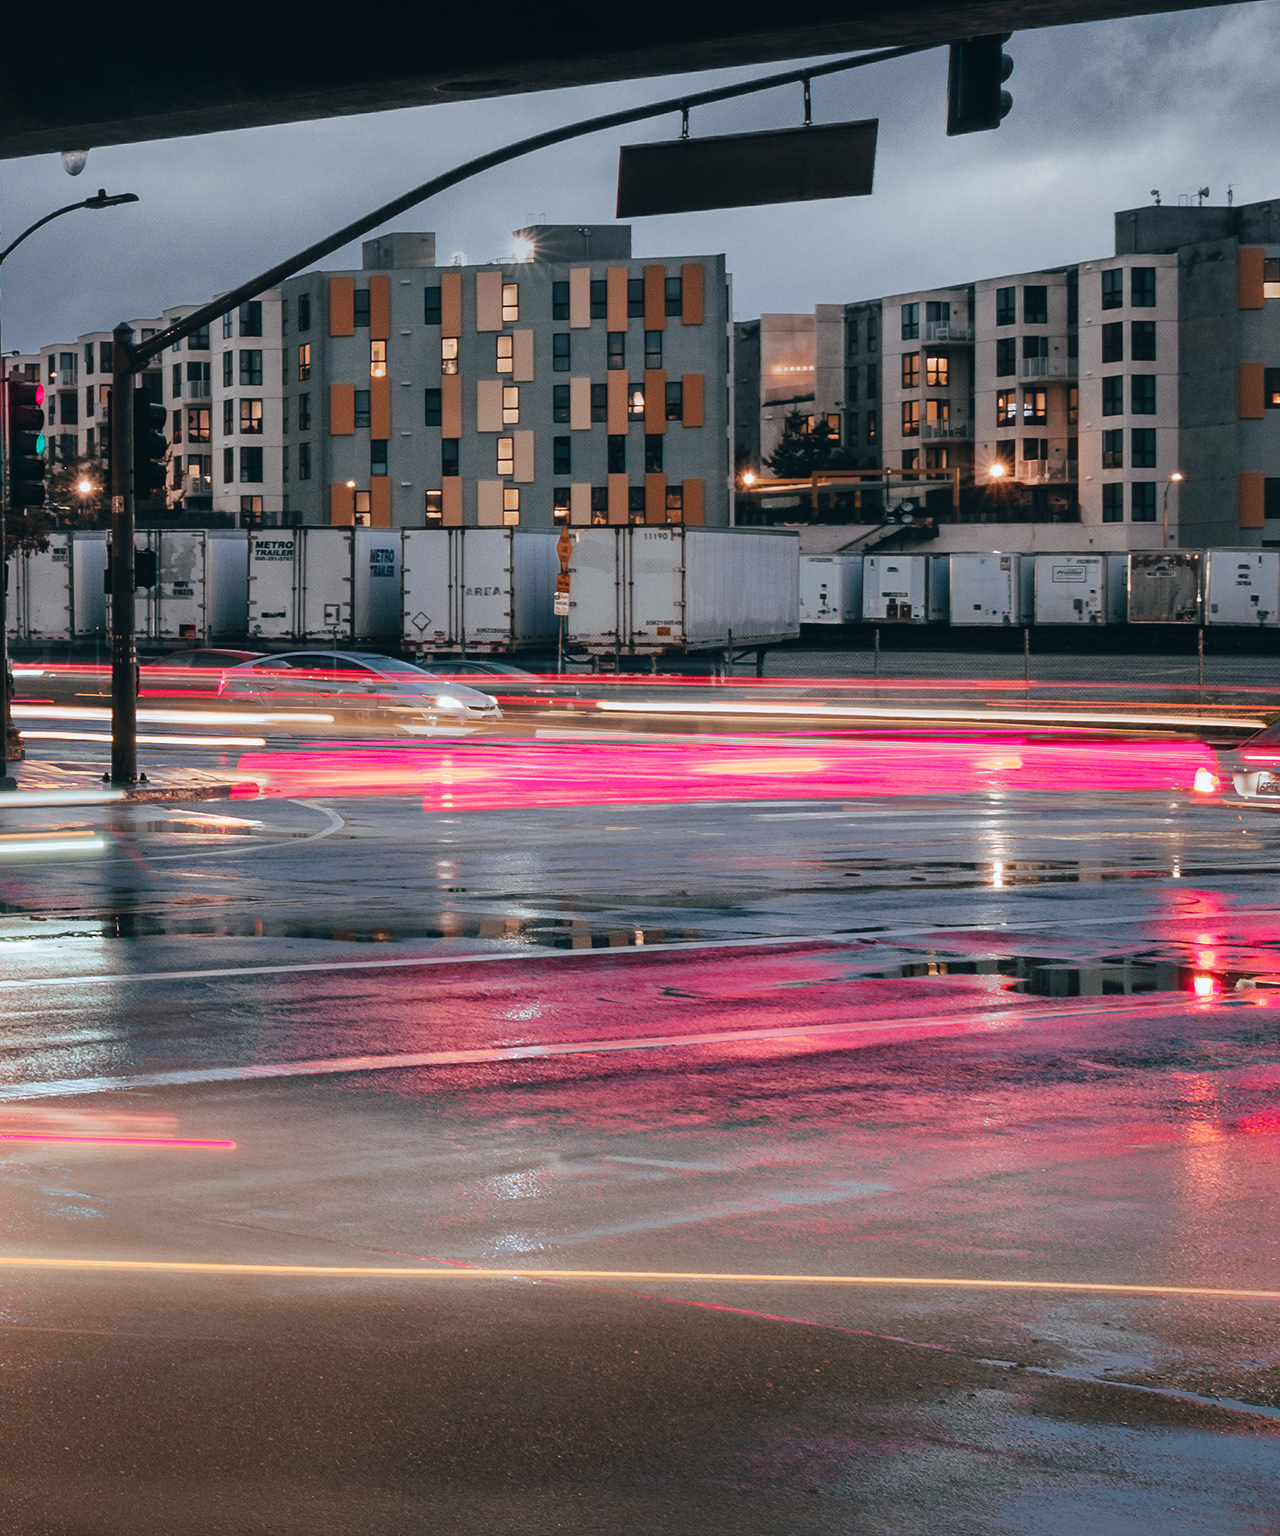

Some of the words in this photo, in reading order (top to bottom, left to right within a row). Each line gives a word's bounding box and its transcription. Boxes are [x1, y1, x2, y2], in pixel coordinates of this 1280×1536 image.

[644, 532, 668, 540] 11190
[255, 541, 293, 549] METRO
[370, 549, 395, 563] METRO
[370, 565, 395, 577] TRAILER
[466, 587, 502, 596] AREA
